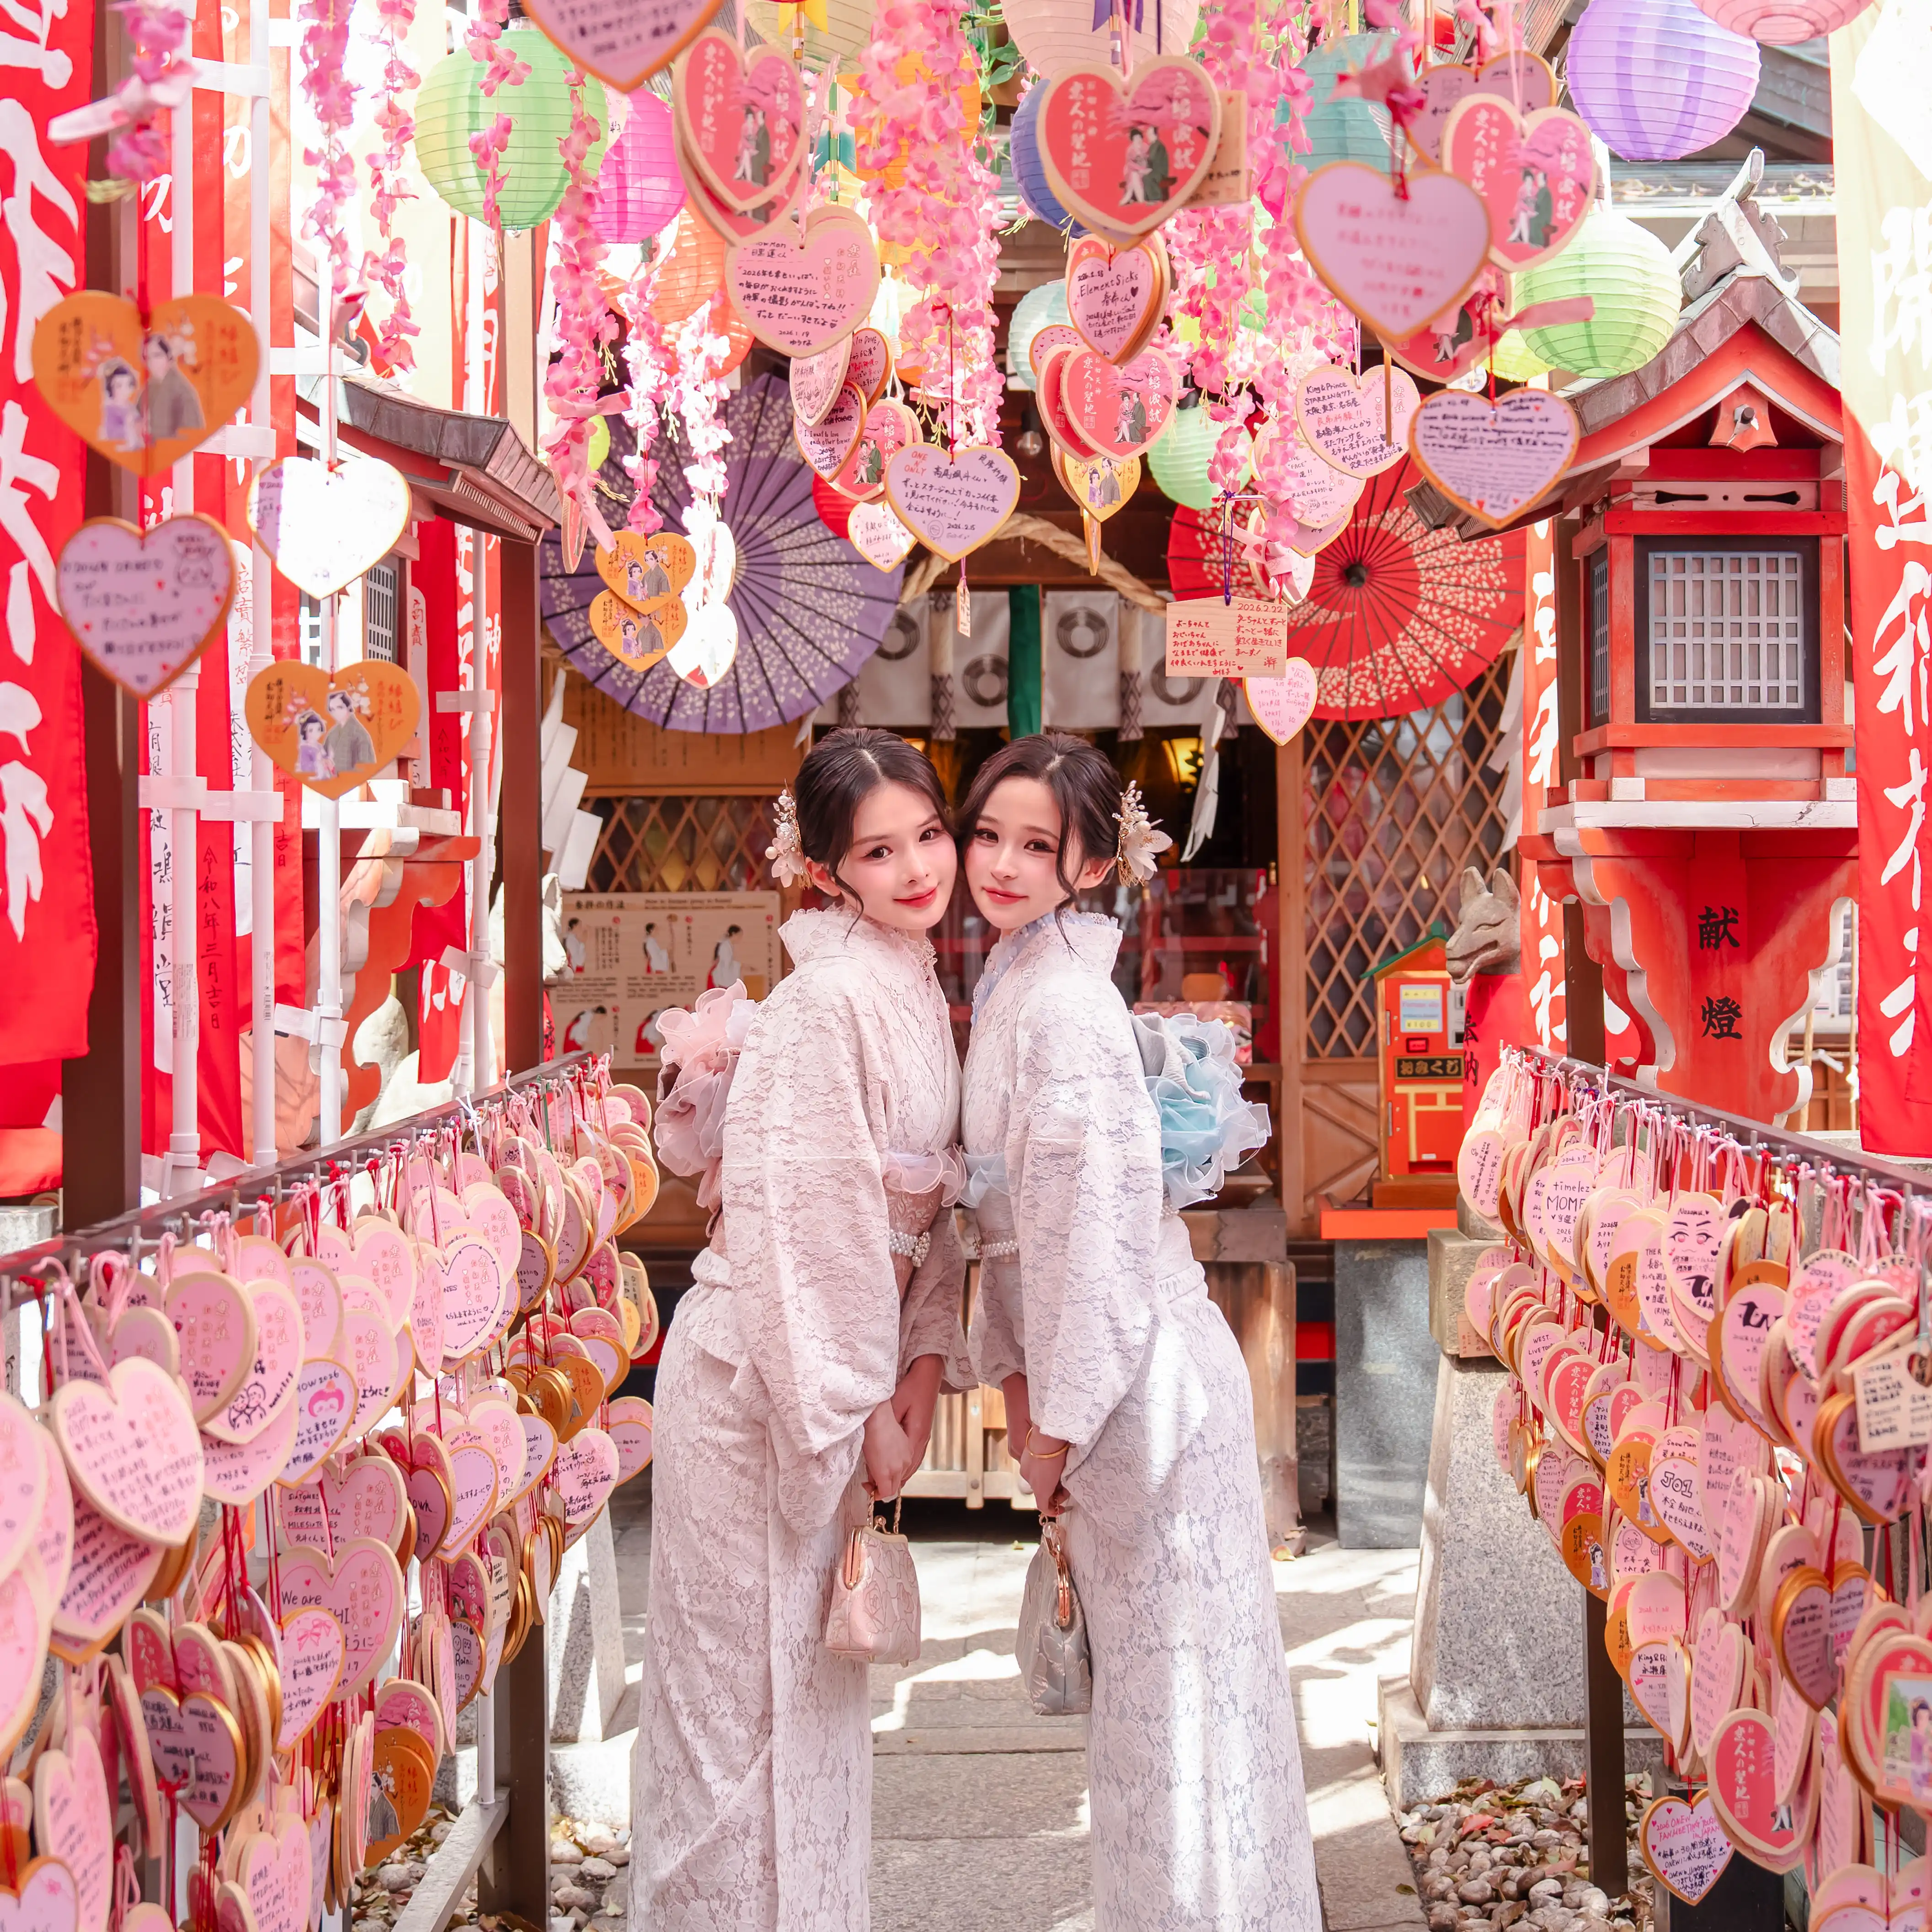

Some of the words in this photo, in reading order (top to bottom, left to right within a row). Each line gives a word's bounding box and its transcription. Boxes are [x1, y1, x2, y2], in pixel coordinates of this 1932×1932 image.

[1068, 81, 1094, 170] 恋人の聖地
[1083, 356, 1097, 415] 恋人の聖地
[1148, 358, 1163, 424] 良縁成就
[678, 546, 688, 575] 縁結び
[671, 603, 680, 631] 縁結び
[1238, 603, 1284, 613] 2026.2.22
[388, 684, 404, 731] 縁結び
[198, 845, 223, 1030] 令和八年三月吉日
[1697, 905, 1742, 1040] 献燈
[1400, 1059, 1459, 1076] おみくじ
[1464, 1009, 1479, 1087] 奉納
[1569, 1366, 1581, 1419] 恋人の聖地
[281, 1590, 298, 1605] We
[301, 1594, 322, 1606] are
[1734, 1724, 1751, 1800] 恋人の聖地
[1670, 1815, 1691, 1828] ONEW
